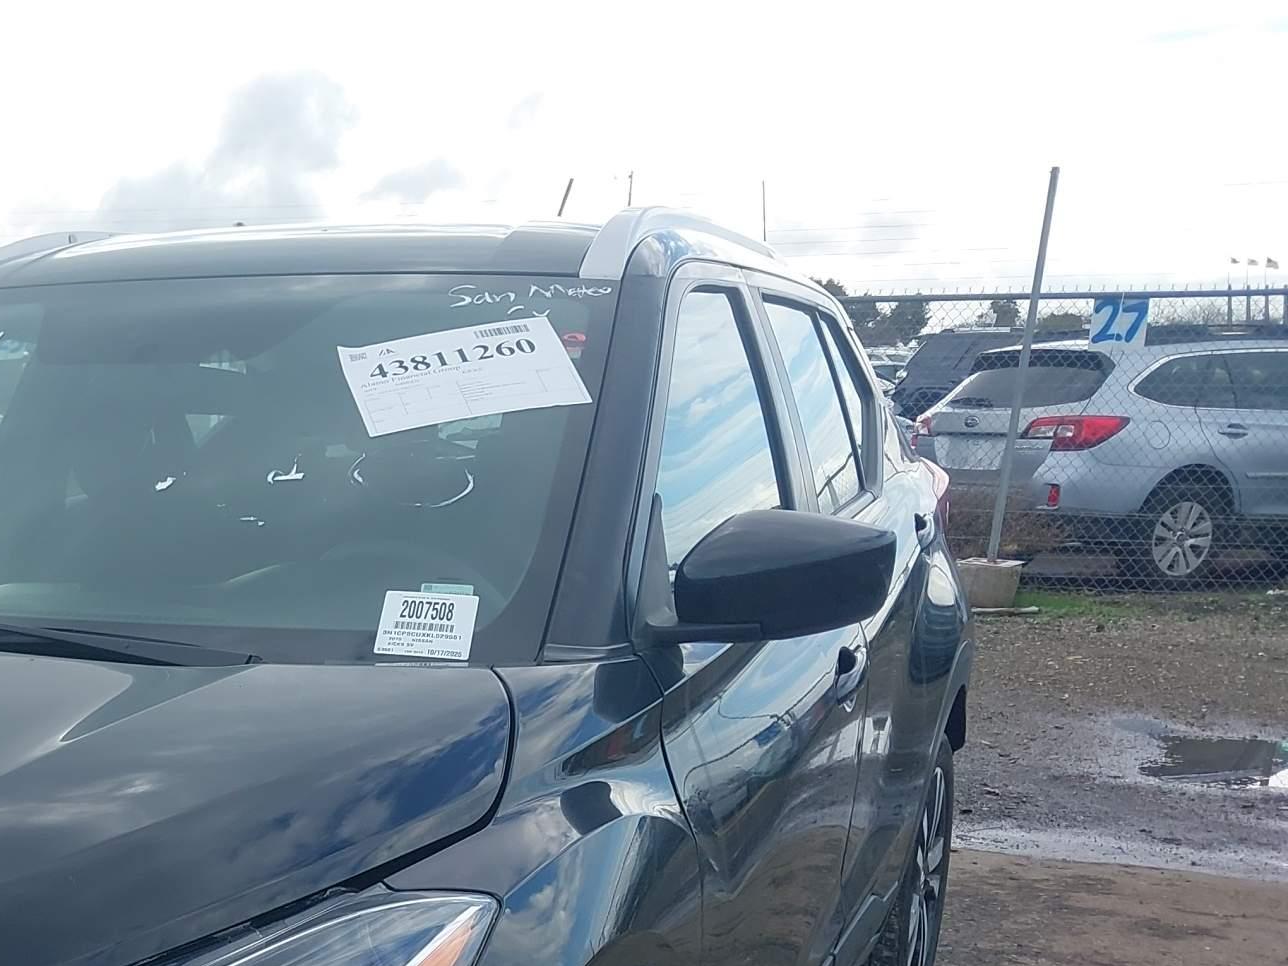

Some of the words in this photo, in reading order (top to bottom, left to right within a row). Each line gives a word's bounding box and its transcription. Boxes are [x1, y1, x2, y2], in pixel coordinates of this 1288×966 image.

[448, 285, 516, 307] San
[1091, 297, 1149, 344] 27
[369, 338, 536, 379] 43811260
[400, 599, 455, 621] 2007508
